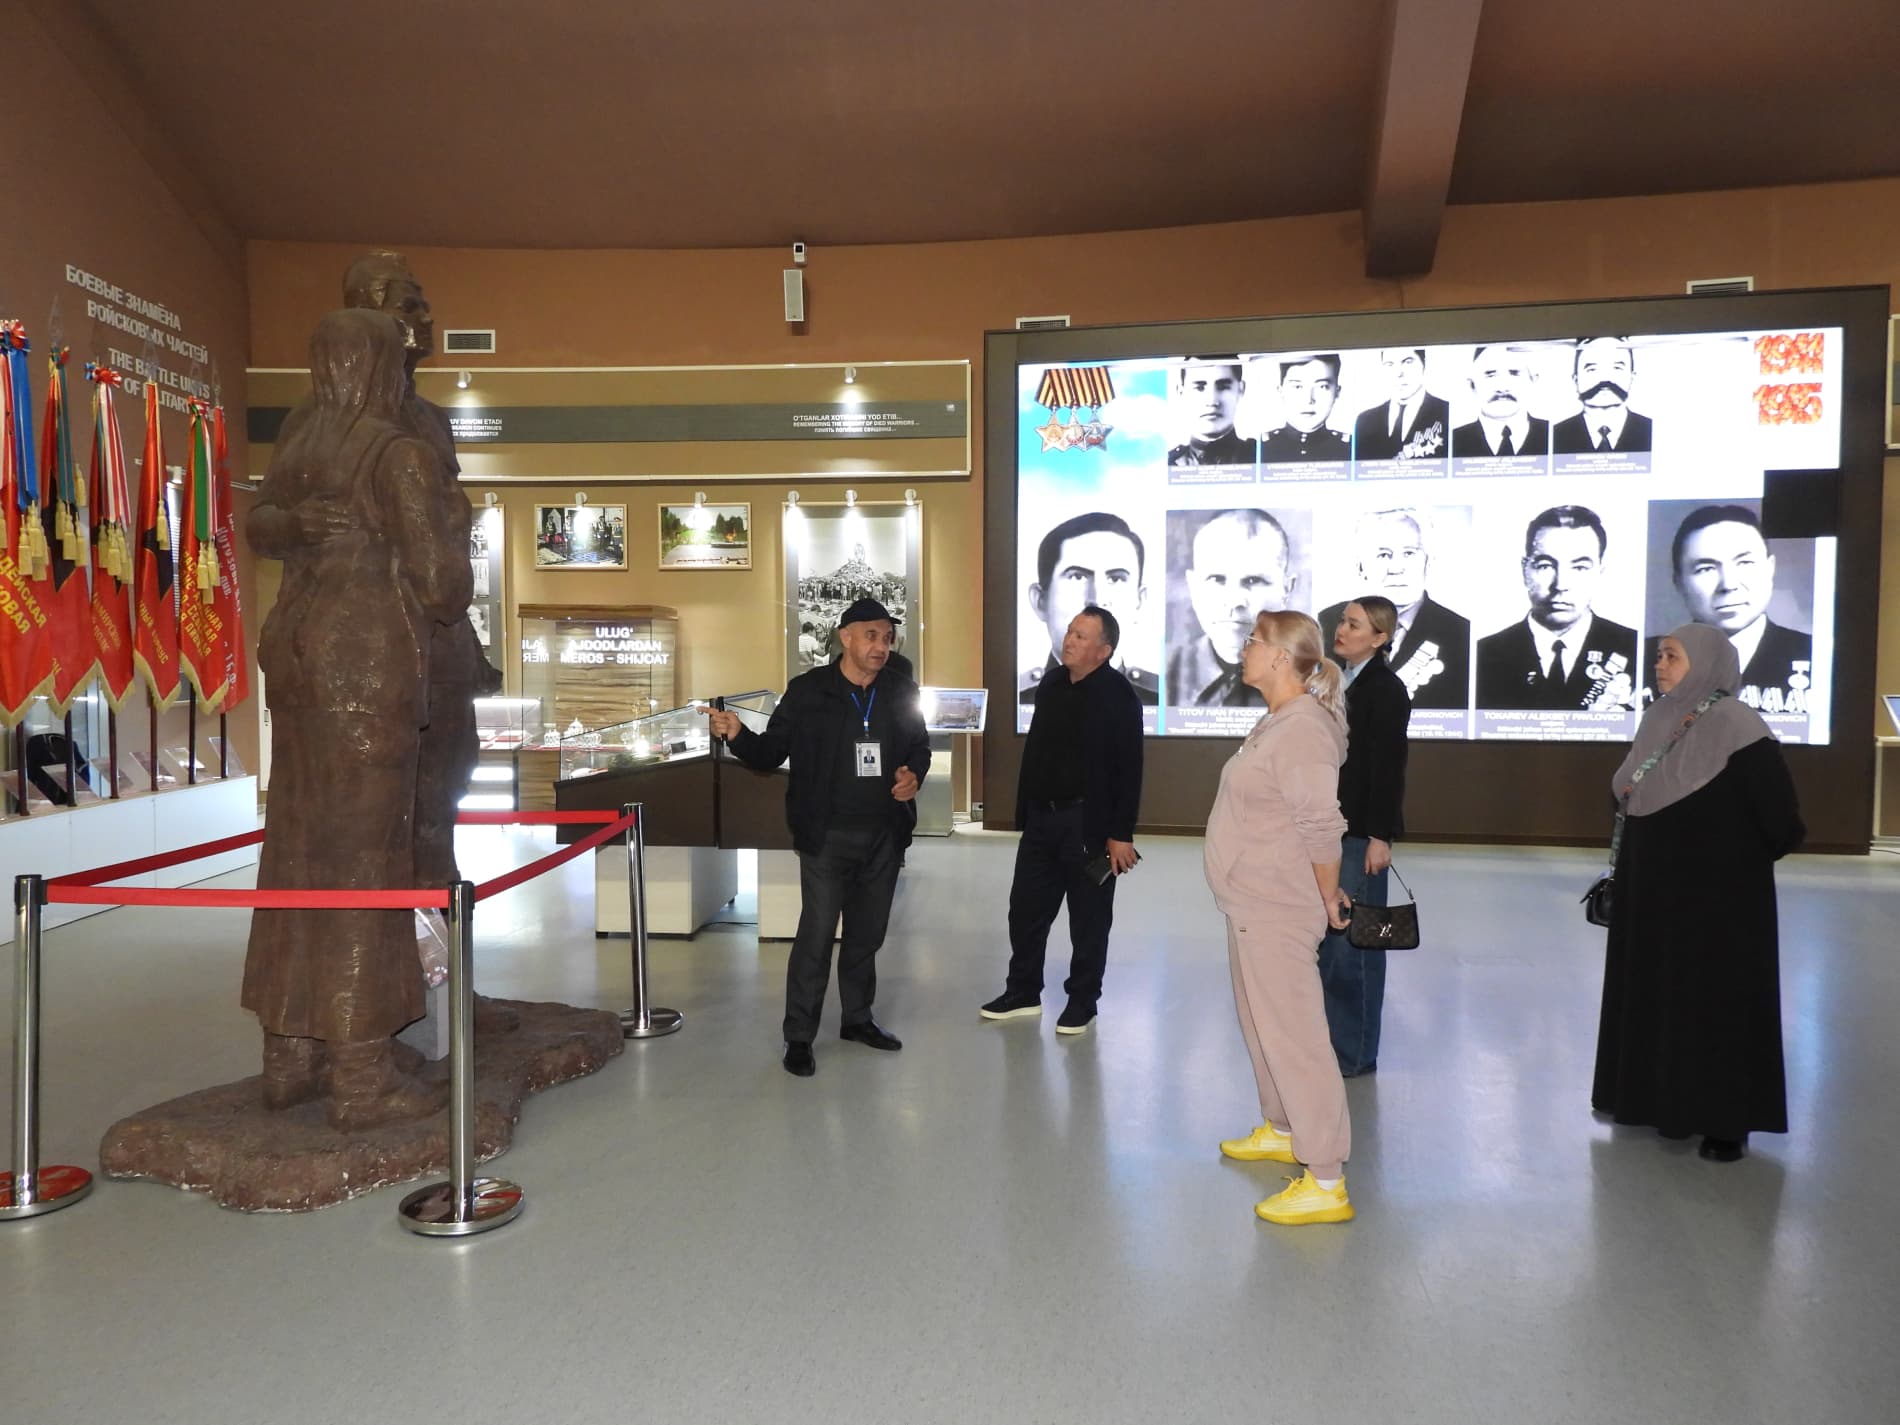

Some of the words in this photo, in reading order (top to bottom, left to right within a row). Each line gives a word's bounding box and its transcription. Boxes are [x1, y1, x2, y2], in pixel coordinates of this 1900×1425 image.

[66, 264, 123, 305] БОЕВЫЕ
[125, 292, 181, 331] ЗНАМЁНА
[88, 299, 165, 347] ВОЙСКОВЫХ
[166, 335, 208, 365] ЧАСТЕЙ
[108, 347, 133, 371] THE
[124, 377, 140, 395] OF
[1753, 382, 1823, 425] 1945
[0, 585, 31, 634] ОВАЯ
[560, 653, 604, 664] MEROS
[616, 653, 669, 664] SHIJOAT
[568, 640, 662, 651] AJDODLARDAN
